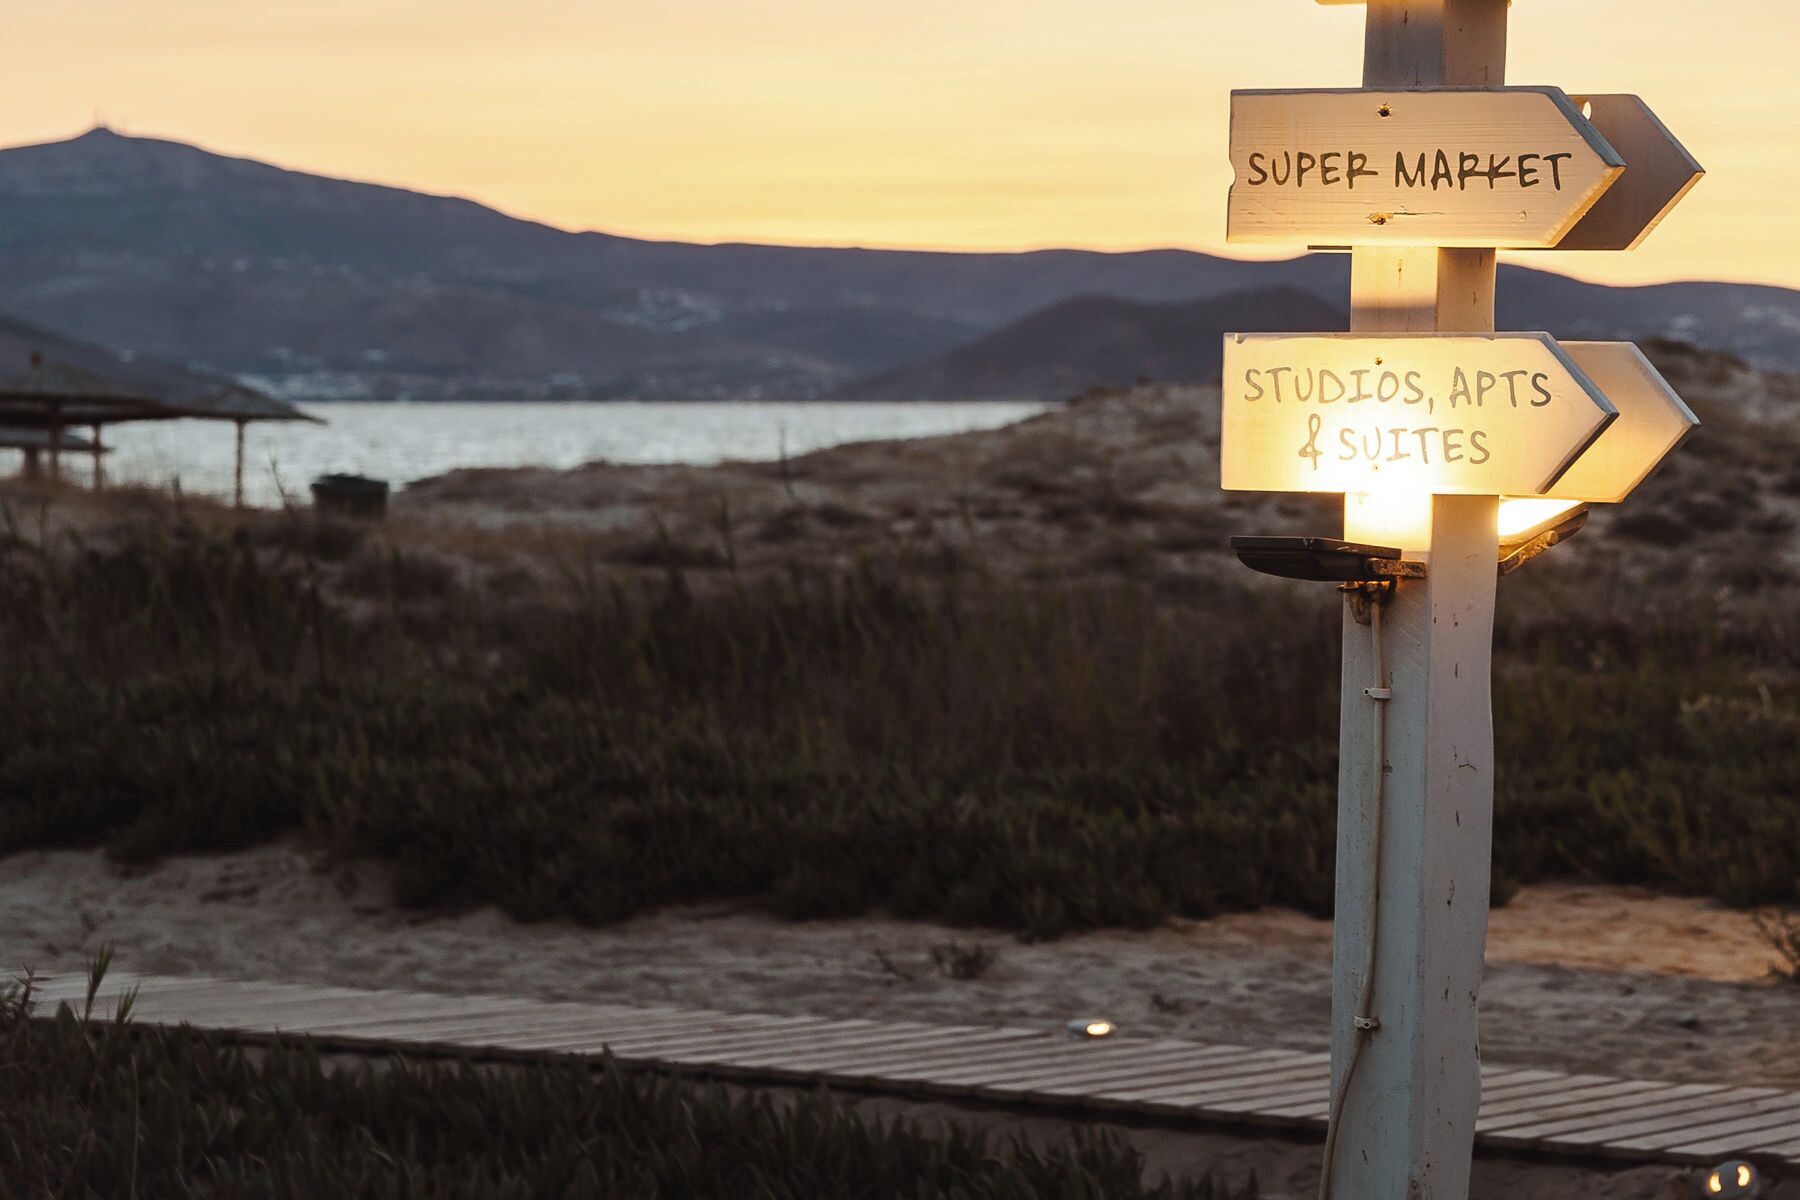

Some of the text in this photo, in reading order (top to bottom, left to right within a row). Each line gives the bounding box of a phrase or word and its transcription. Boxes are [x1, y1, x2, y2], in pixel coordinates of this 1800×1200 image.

[1246, 148, 1573, 191] SUPER MARKET
[1243, 365, 1553, 415] STUDIOS, APTS
[1297, 412, 1491, 471] & SUITES
